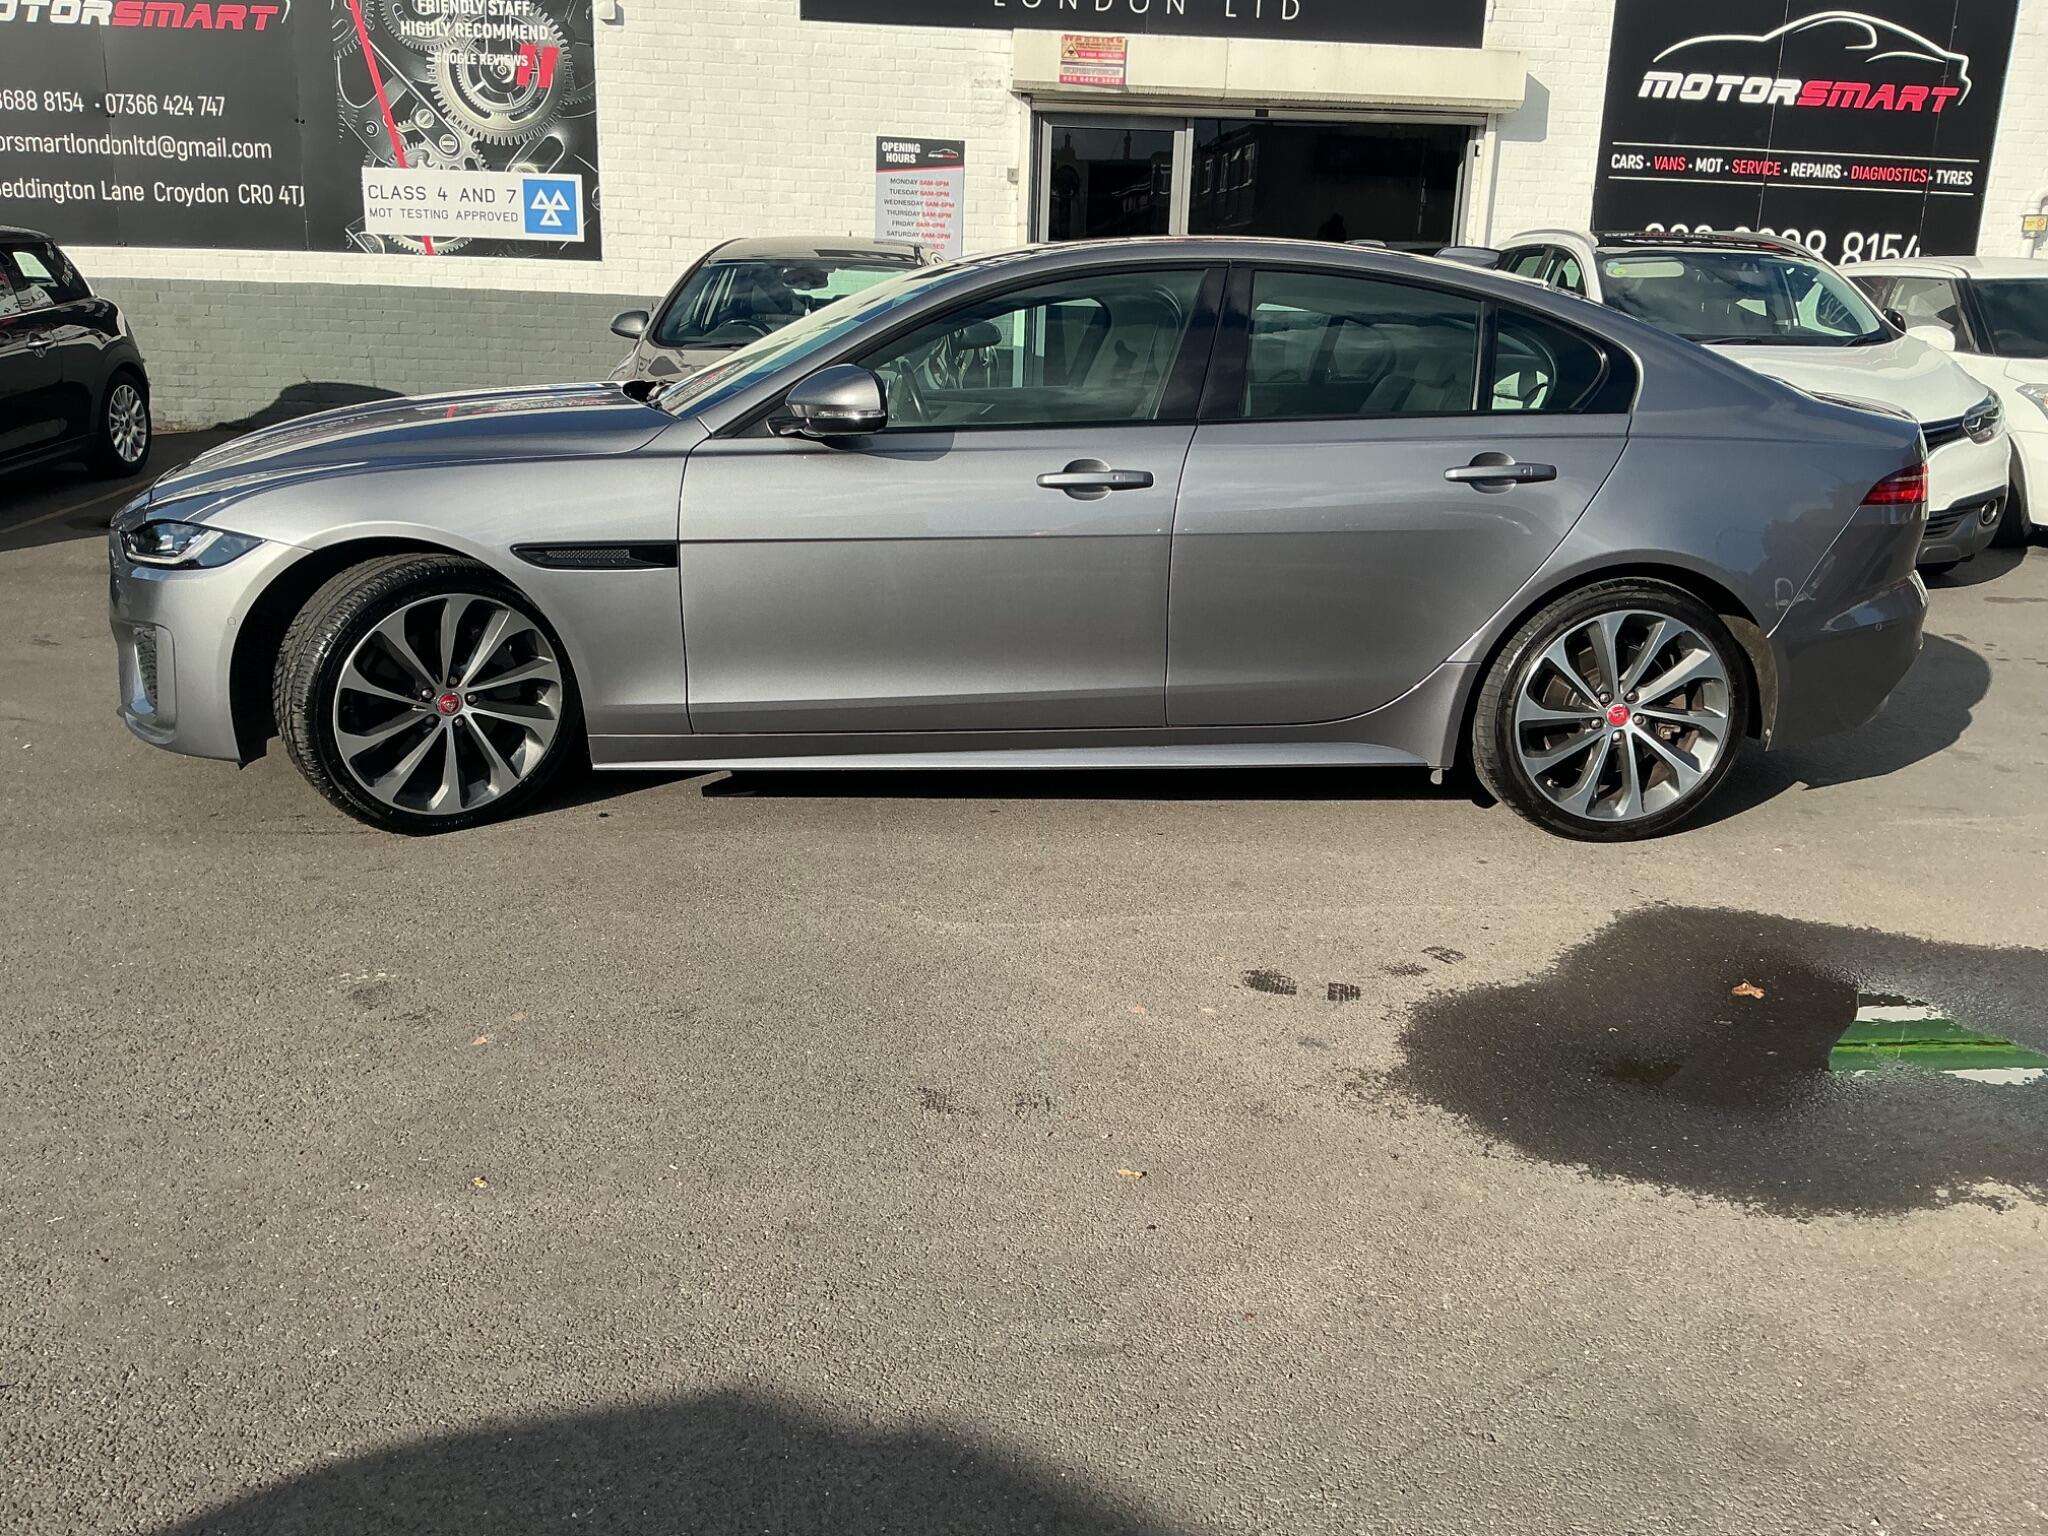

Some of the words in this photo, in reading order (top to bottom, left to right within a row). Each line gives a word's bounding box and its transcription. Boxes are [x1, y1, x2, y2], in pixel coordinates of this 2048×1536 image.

[417, 0, 484, 15] FRIENDLY
[400, 20, 451, 37] HIGHLY
[435, 52, 477, 66] GOOGLE
[480, 53, 528, 67] REVIEWS
[1637, 71, 1960, 113] MOTORSMART
[0, 90, 38, 111] 688
[44, 91, 84, 112] 8154
[105, 93, 158, 114] 07366
[163, 95, 194, 116] 424
[197, 96, 225, 117] 747
[882, 141, 921, 154] OPENING
[886, 153, 917, 164] HOURS
[1611, 154, 1644, 170] CARS
[1654, 156, 1686, 171] VANS
[1695, 158, 1723, 173] MOT
[1731, 160, 1781, 176] SERVICE
[1790, 163, 1842, 179] REPAIRS
[1850, 166, 1928, 183] DIAGNOSTICS
[1936, 169, 1973, 186] TYRES
[890, 178, 918, 186] MONDAY
[0, 178, 95, 203] eddington
[101, 180, 145, 201] Lane
[154, 182, 229, 207] Croydon
[279, 185, 305, 207] 4TJ
[367, 184, 427, 201] CLASS
[437, 188, 448, 202] 4
[459, 188, 496, 204] AND
[506, 189, 517, 204] 7
[890, 188, 918, 196] TUESDAY
[369, 208, 392, 218] MOT
[400, 209, 449, 220] TESTING
[456, 211, 519, 222] APPROVED
[886, 230, 920, 238] SATURDAY
